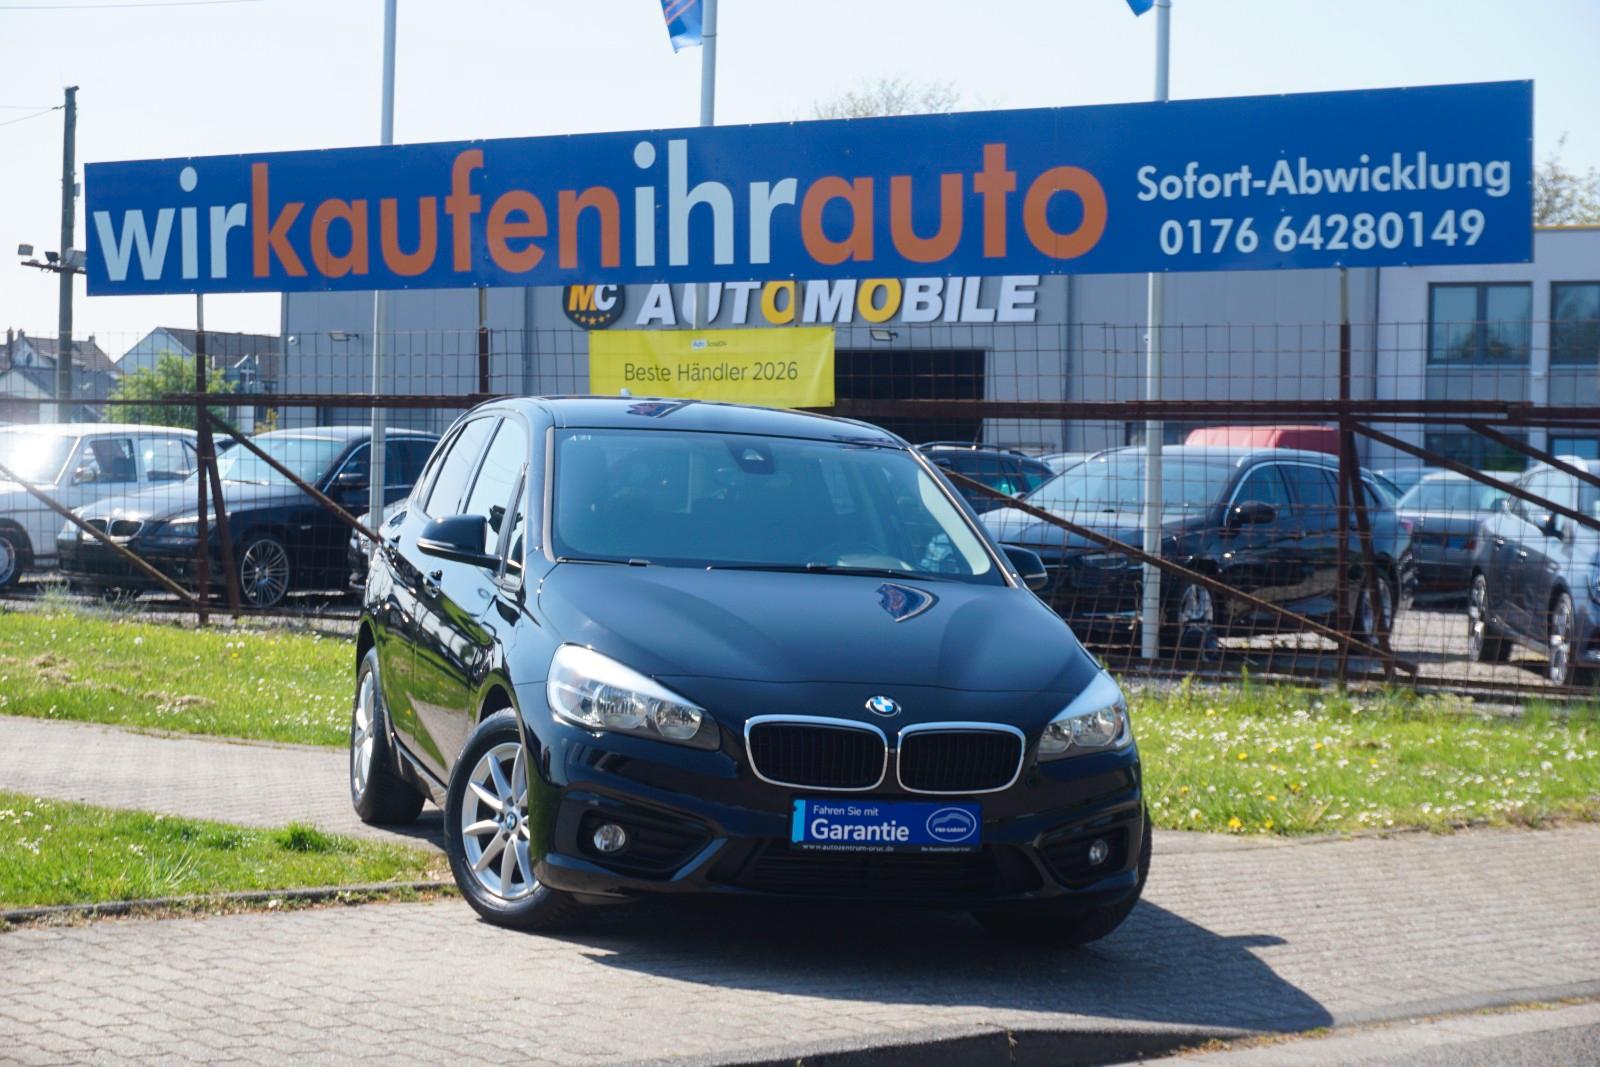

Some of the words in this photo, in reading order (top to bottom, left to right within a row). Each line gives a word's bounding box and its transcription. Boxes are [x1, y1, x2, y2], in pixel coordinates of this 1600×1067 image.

[1137, 151, 1511, 201] Sofort-Abwicklung
[93, 139, 1108, 282] wirkaufenihrauto
[1160, 217, 1258, 255] 0176
[1273, 209, 1486, 252] 64280149
[568, 284, 618, 311] MC
[636, 275, 1040, 325] AUTOMOBILE
[624, 362, 672, 382] Beste
[677, 361, 749, 383] Händler
[753, 360, 798, 382] 2026
[813, 805, 845, 816] Fahren
[847, 806, 862, 816] Sie
[863, 806, 879, 816] mit
[811, 818, 910, 842] Garantie
